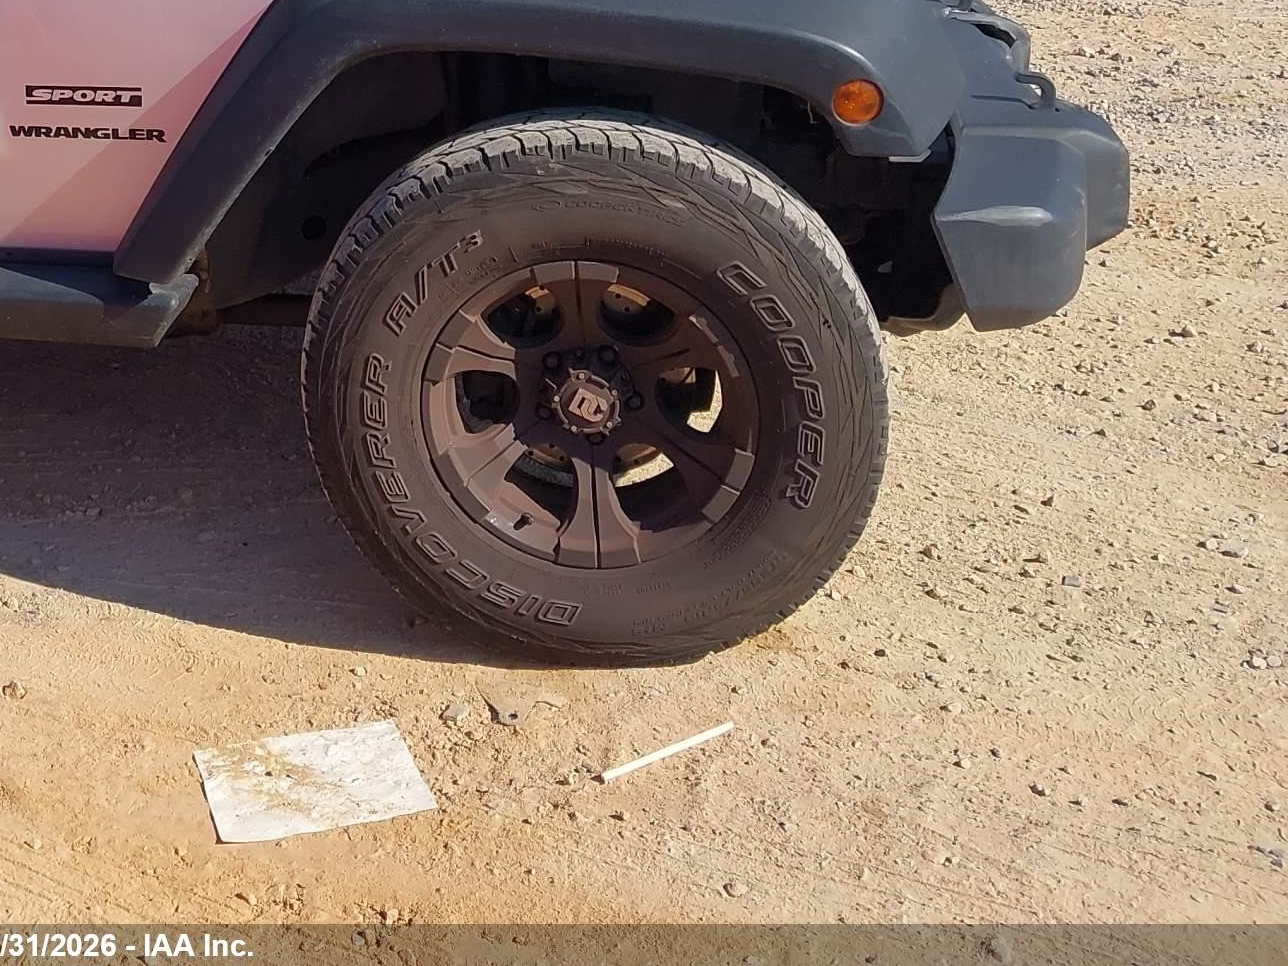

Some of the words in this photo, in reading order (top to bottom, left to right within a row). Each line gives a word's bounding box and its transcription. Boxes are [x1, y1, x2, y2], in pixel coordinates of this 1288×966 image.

[9, 125, 167, 143] WRANGLER
[29, 87, 143, 104] SPORT
[716, 261, 826, 509] COOPER
[362, 353, 584, 626] DISCOVERER
